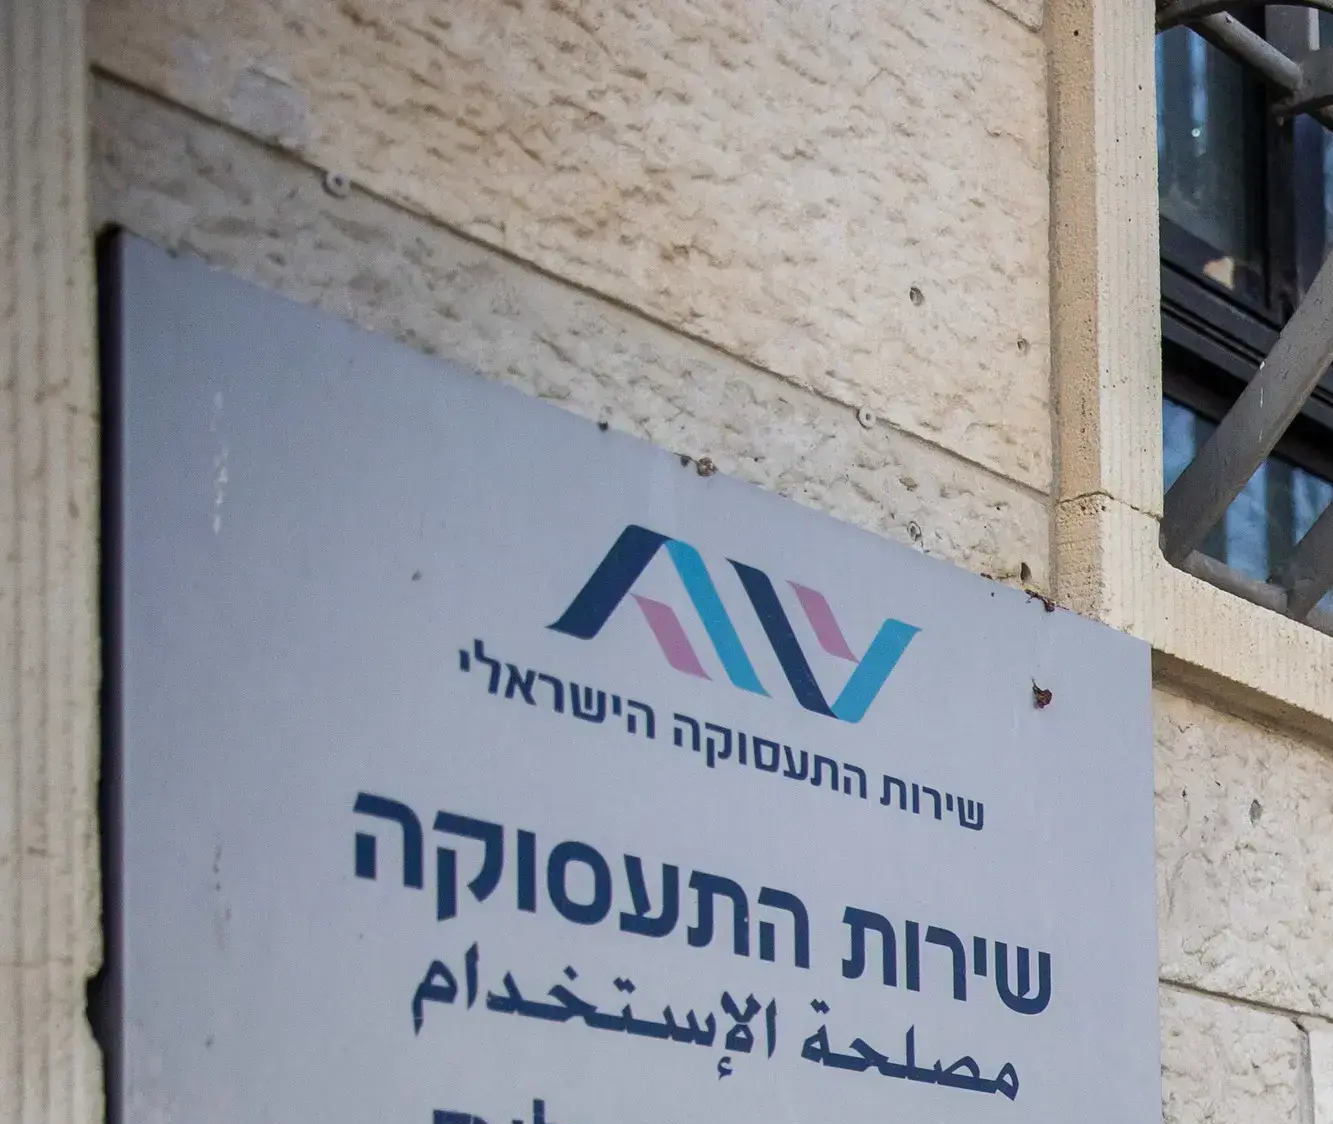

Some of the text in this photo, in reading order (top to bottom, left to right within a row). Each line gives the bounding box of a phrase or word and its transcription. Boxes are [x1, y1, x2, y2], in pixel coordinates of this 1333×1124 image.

[458, 638, 985, 832] שירות התעסוקה הישראלי
[352, 791, 1052, 1016] שירות התעסוקה
[410, 941, 1020, 1102] مصلحة الإستخدام
